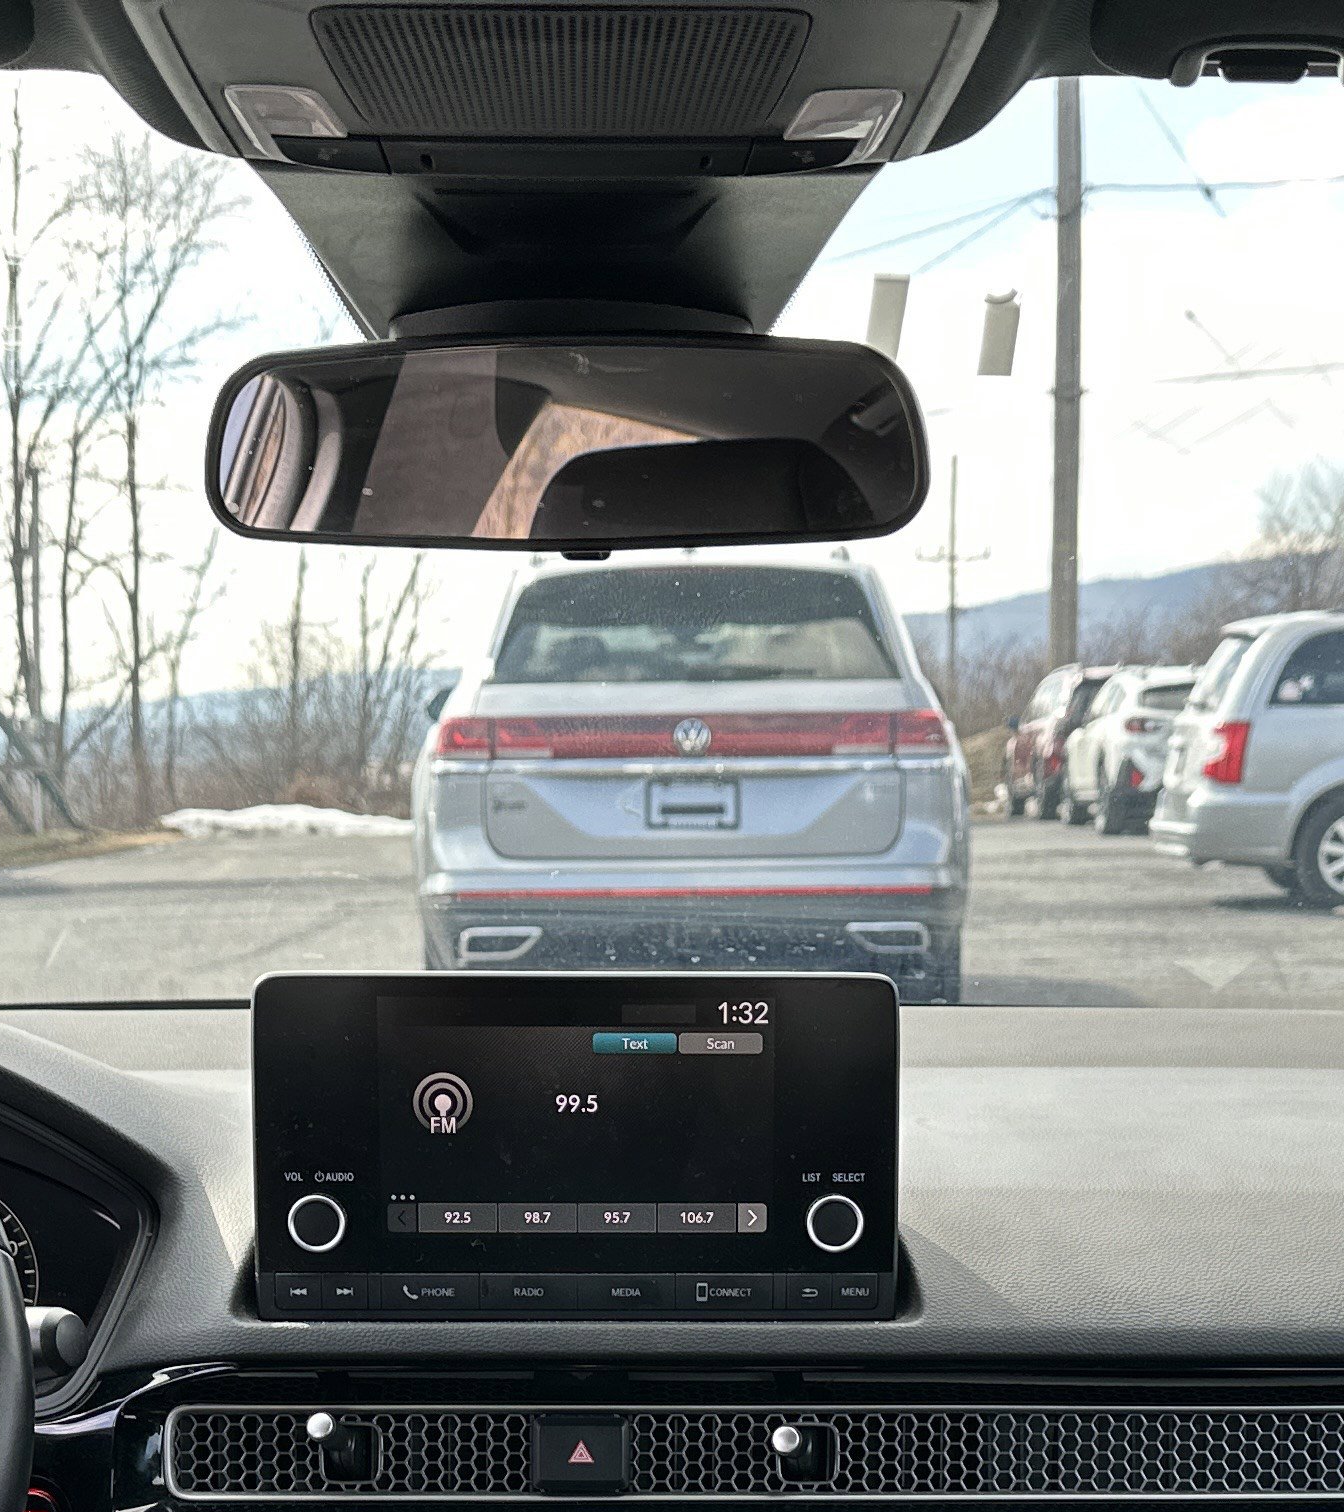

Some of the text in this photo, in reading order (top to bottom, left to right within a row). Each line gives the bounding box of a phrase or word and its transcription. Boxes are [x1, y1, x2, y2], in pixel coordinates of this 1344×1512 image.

[718, 1001, 769, 1024] 1:32
[622, 1037, 649, 1050] Text
[706, 1037, 735, 1050] Scan
[556, 1094, 598, 1113] 99.5
[430, 1117, 456, 1134] FM
[284, 1171, 303, 1182] VOL
[325, 1171, 354, 1182] AUDIO
[802, 1172, 821, 1182] LIST
[832, 1172, 865, 1183] SELECT
[444, 1211, 471, 1224] 92.5
[524, 1211, 551, 1224] 98.7
[604, 1211, 630, 1224] 95.7
[680, 1211, 714, 1224] 106.7
[421, 1287, 455, 1297] PHONE
[513, 1287, 544, 1297] RADIO
[611, 1287, 641, 1297] MEDIA
[709, 1287, 752, 1298] CONNECT
[841, 1287, 869, 1297] MENU
